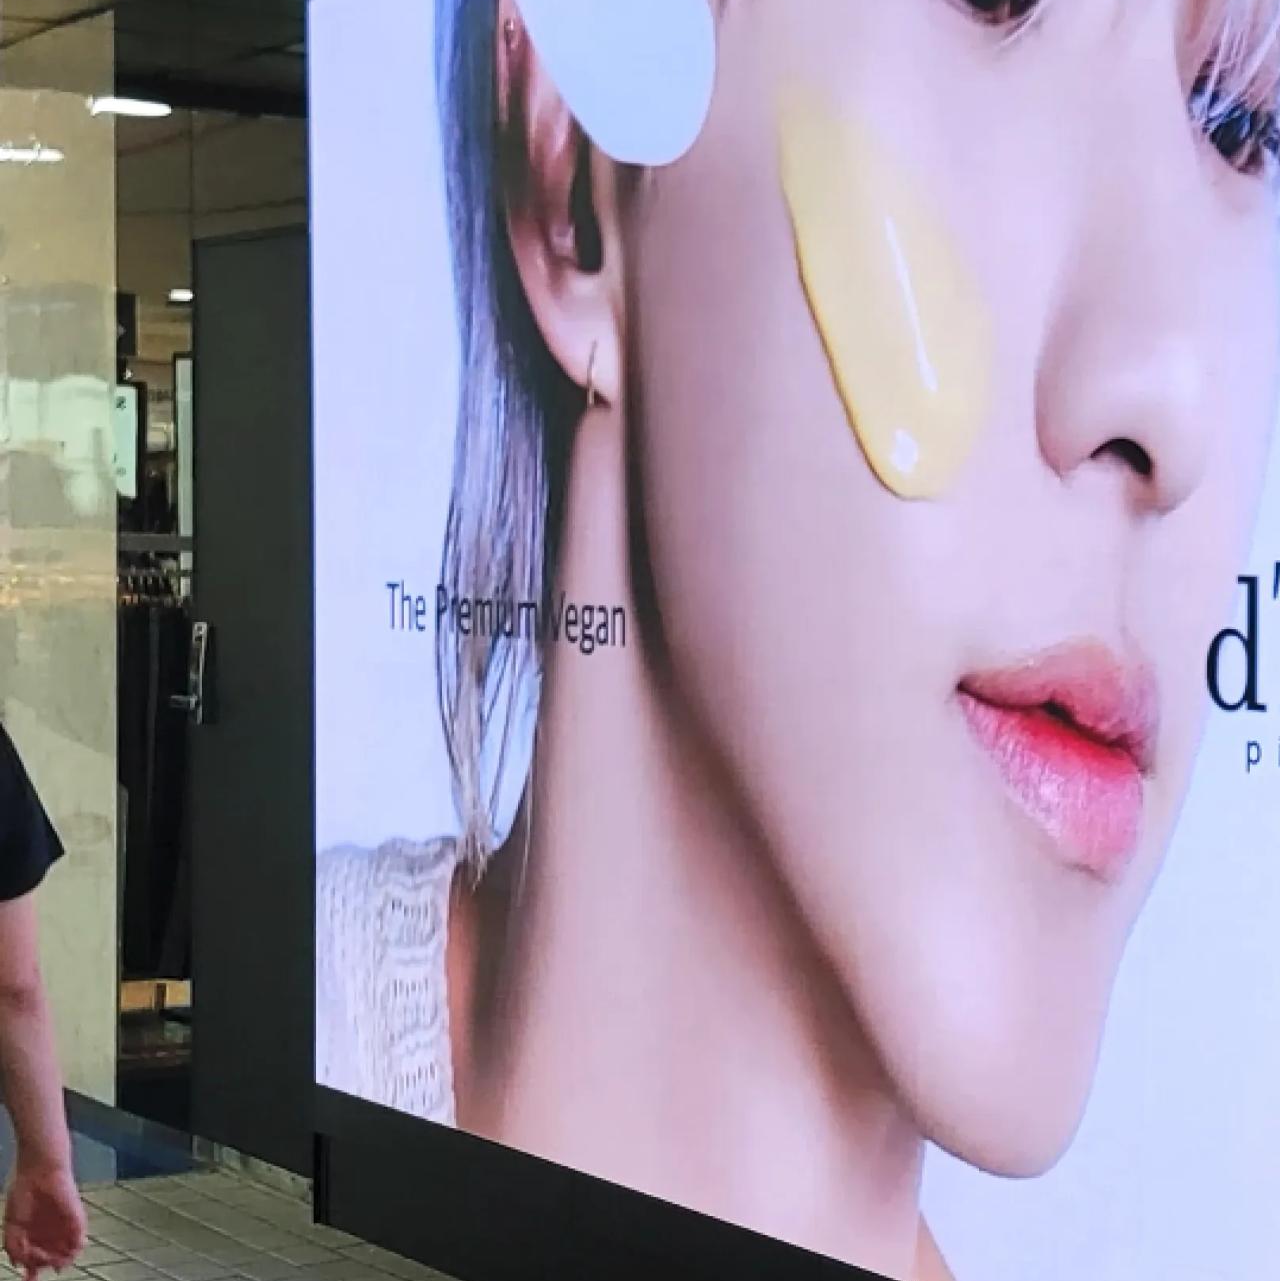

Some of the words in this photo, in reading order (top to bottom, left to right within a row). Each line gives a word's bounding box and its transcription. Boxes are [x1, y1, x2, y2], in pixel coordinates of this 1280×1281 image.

[386, 579, 427, 632] The
[435, 582, 538, 639] Premium
[550, 590, 627, 656] Vegan
